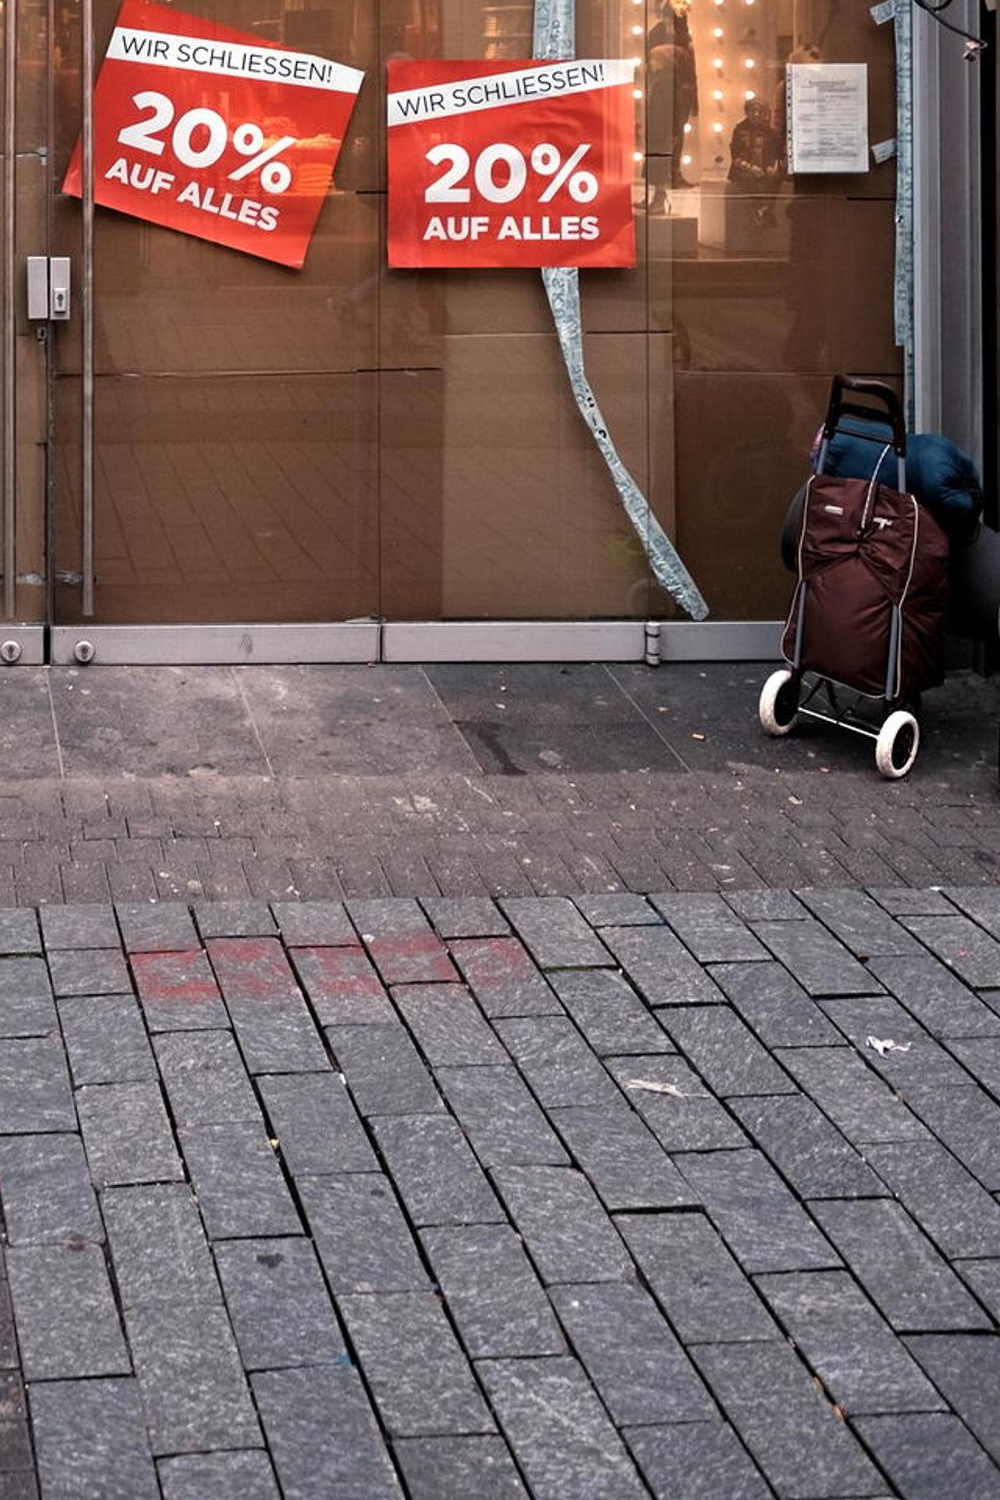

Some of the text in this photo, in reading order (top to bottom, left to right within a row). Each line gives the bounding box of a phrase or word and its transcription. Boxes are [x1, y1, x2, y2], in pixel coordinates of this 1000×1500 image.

[121, 35, 333, 84] WIR SCHLIESSEN!
[397, 63, 605, 117] WIR SCHLIESSEN!
[117, 91, 297, 194] 20%
[105, 158, 280, 231] AUF ALLES
[424, 143, 599, 204] 20%
[423, 216, 600, 240] AUF ALLES
